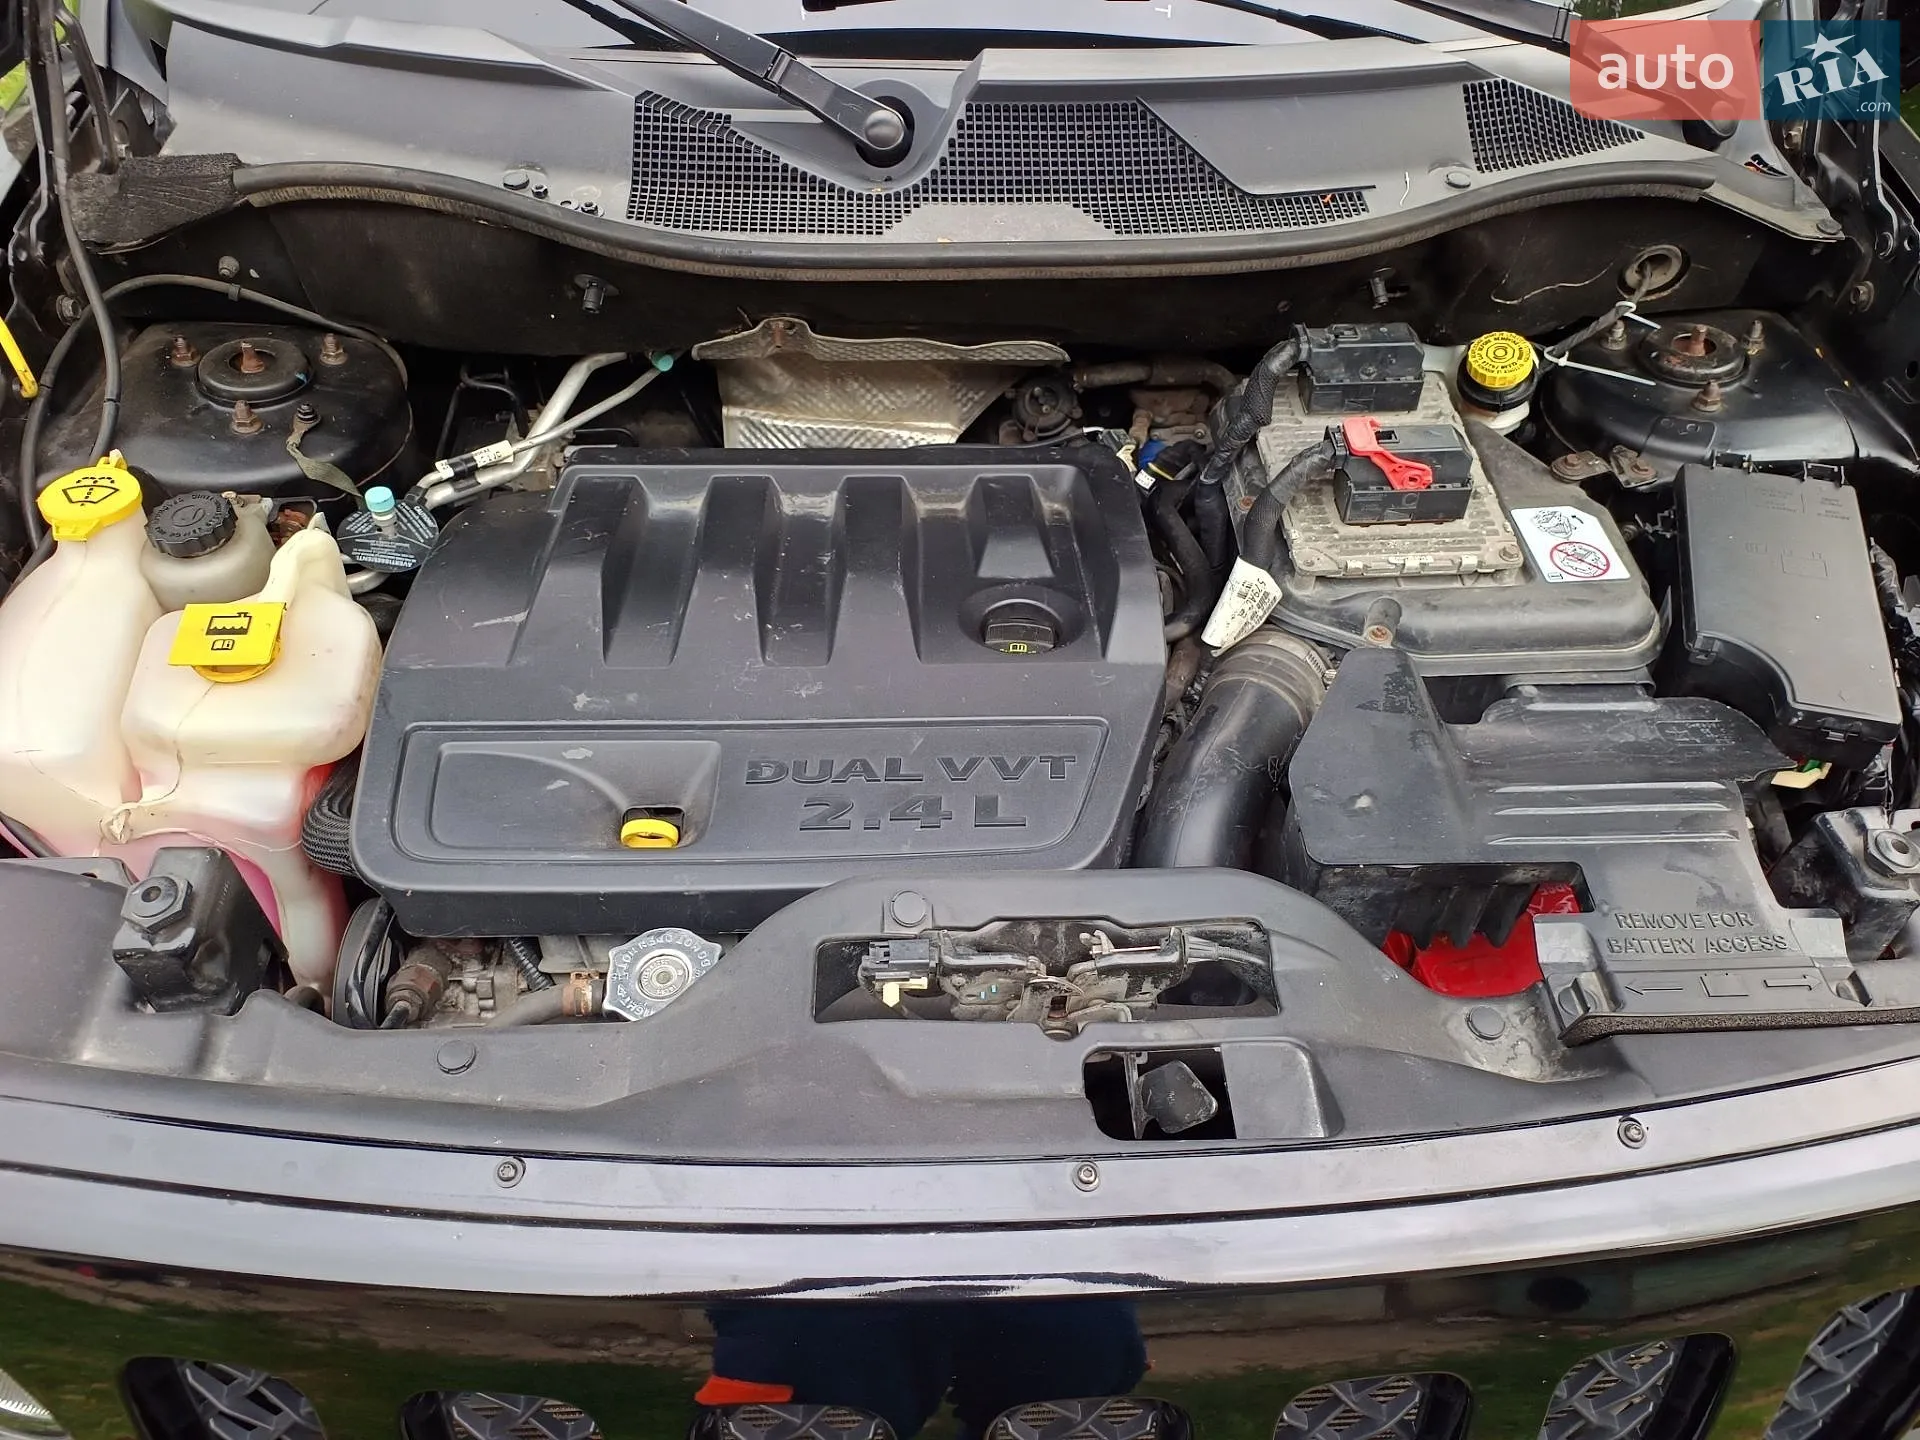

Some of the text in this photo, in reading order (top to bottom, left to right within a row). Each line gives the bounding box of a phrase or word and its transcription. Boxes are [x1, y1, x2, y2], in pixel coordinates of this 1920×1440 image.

[745, 755, 1076, 784] DUAL VVT
[1614, 911, 1754, 930] REMOVE FOR
[1607, 934, 1789, 955] BATTERY ACCESS
